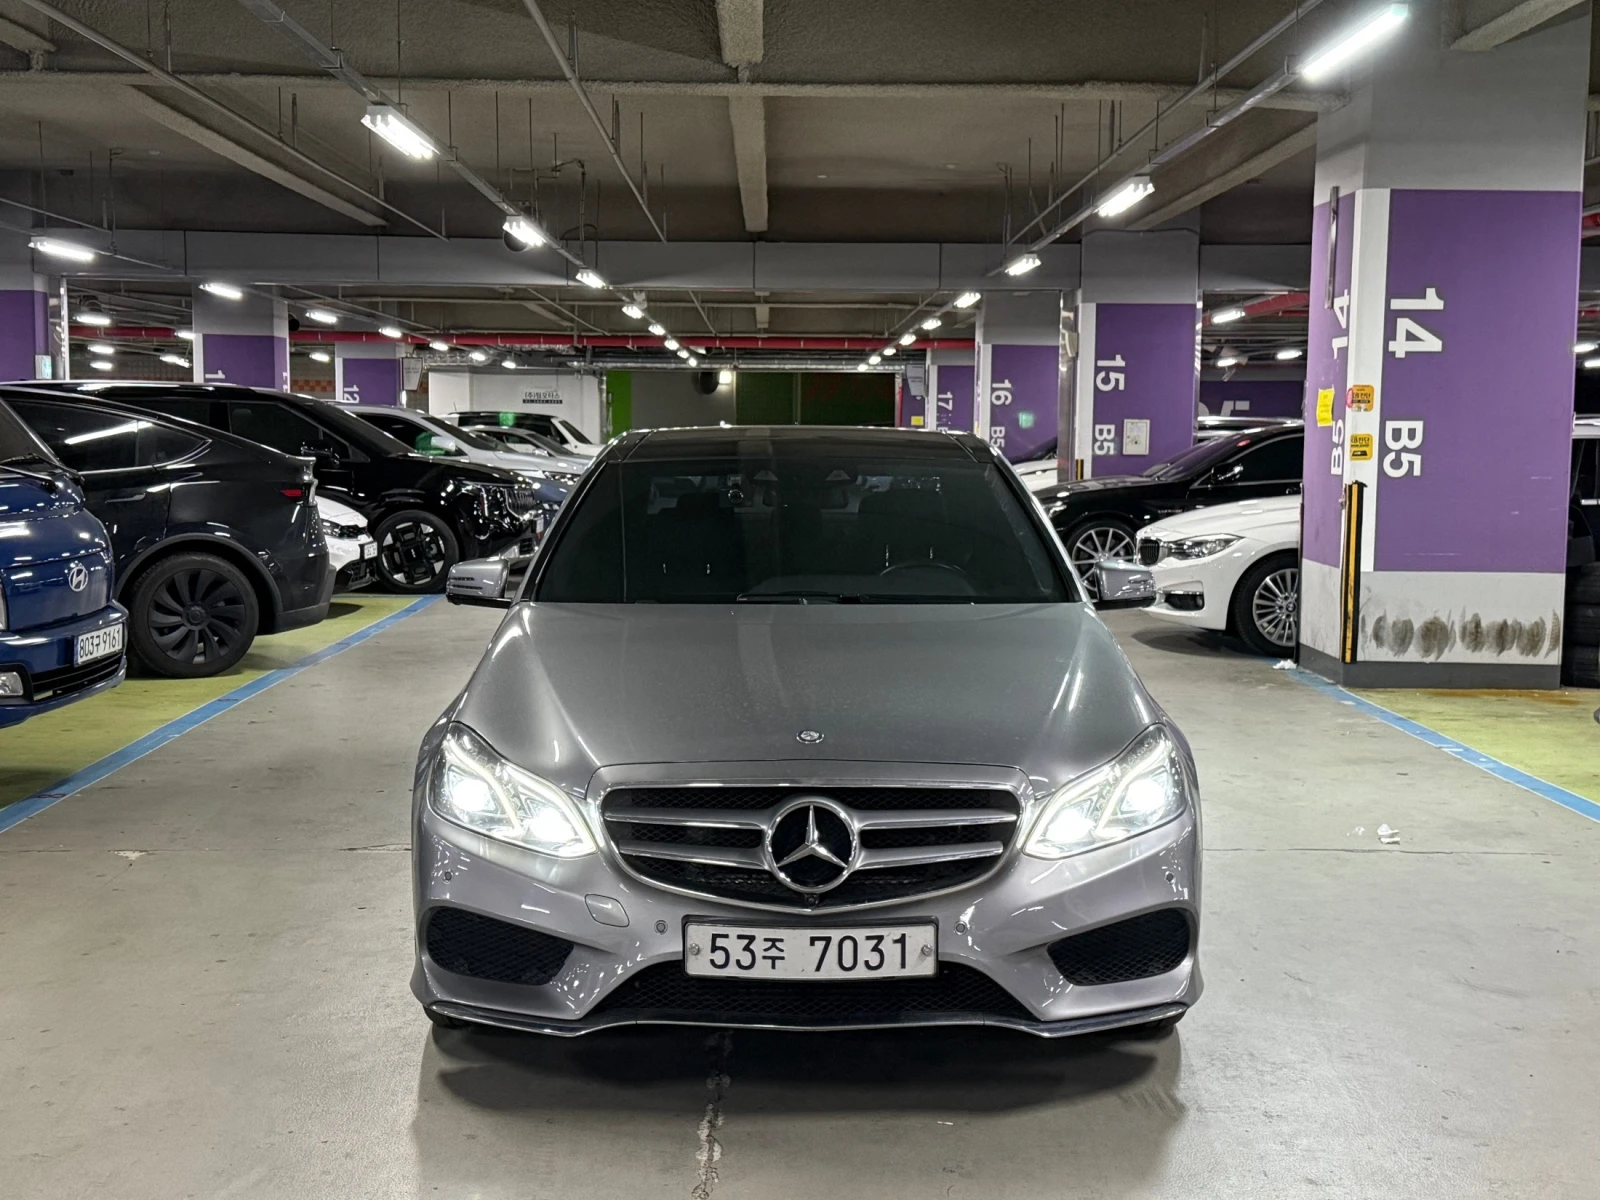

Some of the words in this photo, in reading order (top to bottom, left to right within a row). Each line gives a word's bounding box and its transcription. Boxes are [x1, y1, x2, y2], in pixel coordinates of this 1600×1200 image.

[1331, 289, 1350, 360] 14
[1388, 288, 1444, 359] 14
[1095, 354, 1126, 392] 15
[343, 384, 360, 404] 12
[937, 391, 953, 411] 17
[991, 379, 1013, 406] 16
[990, 426, 1006, 448] B5
[1093, 424, 1116, 456] B5
[1330, 419, 1345, 476] B5
[1382, 420, 1424, 478] B5
[79, 634, 101, 659] 803구
[102, 627, 121, 652] 9161
[709, 933, 786, 970] 53주
[809, 933, 908, 972] 7031
